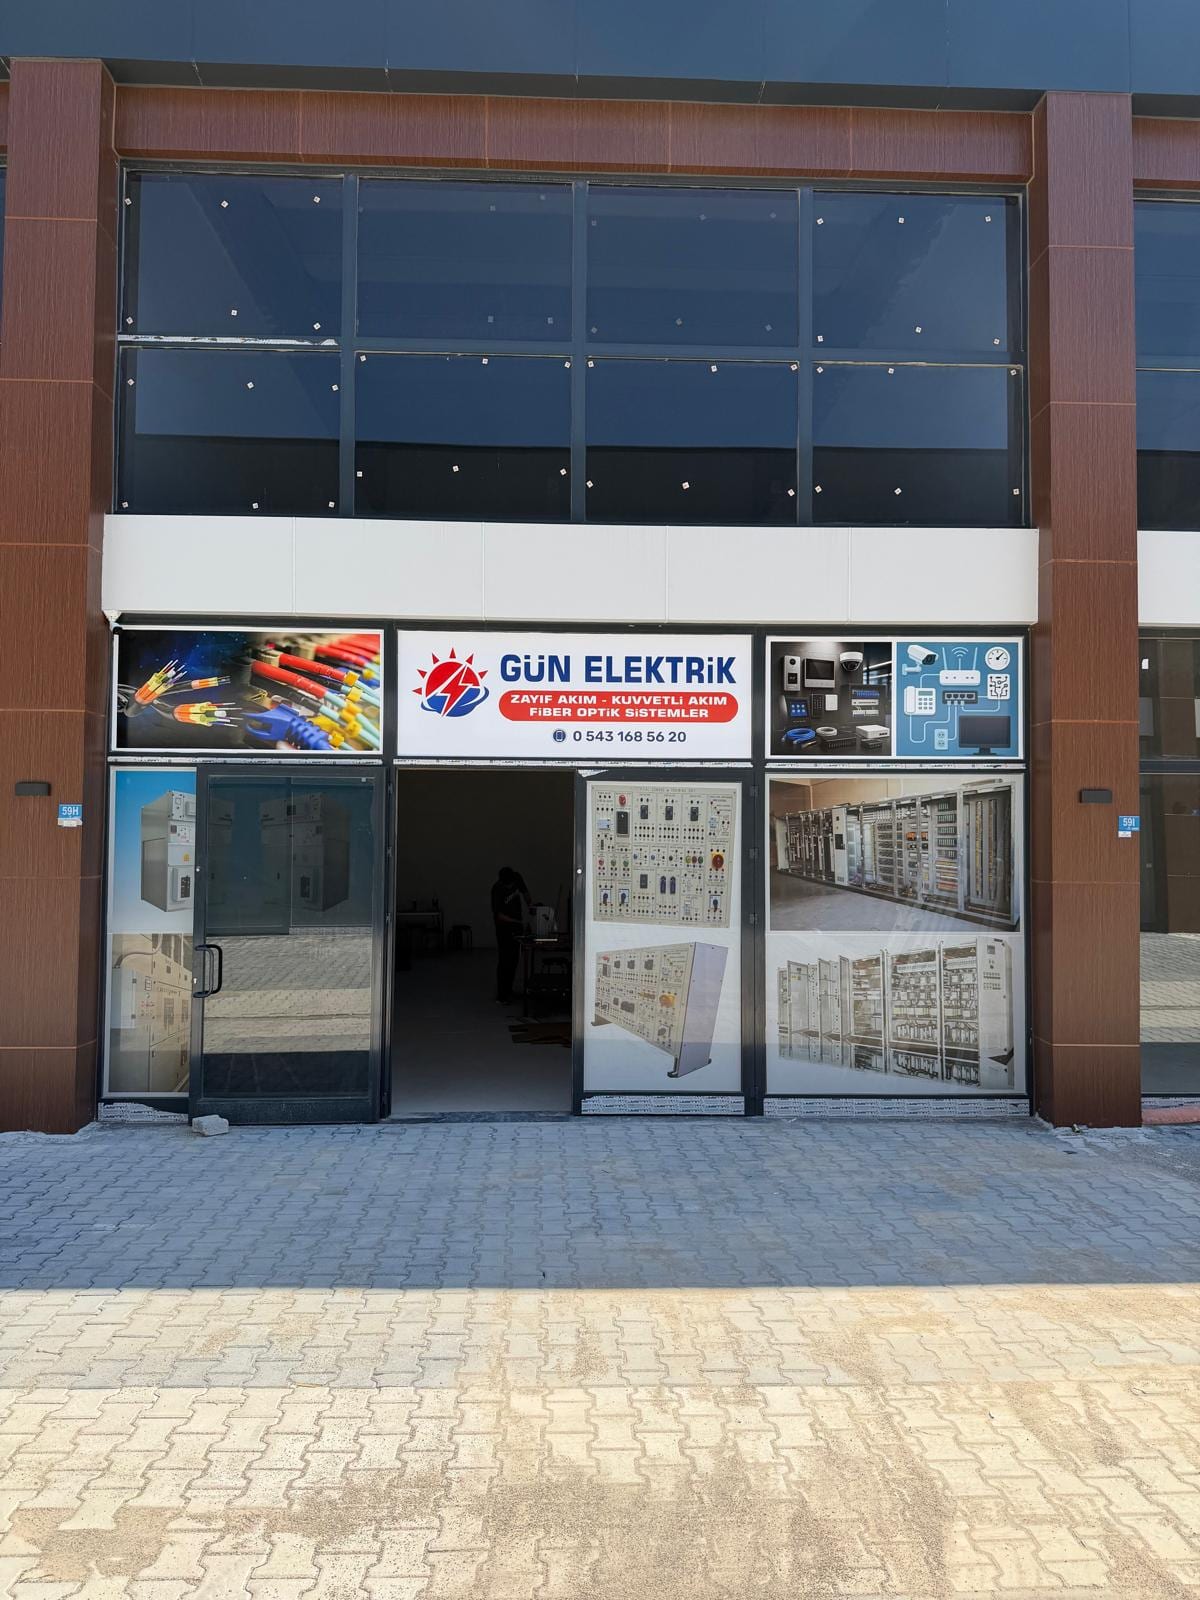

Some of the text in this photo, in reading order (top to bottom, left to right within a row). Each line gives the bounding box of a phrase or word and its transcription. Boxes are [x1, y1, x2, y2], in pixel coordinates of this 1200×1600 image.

[500, 654, 571, 682] GÜN
[510, 694, 553, 704] ZAYIF
[557, 695, 597, 705] AKIM
[687, 696, 728, 706] AKIM
[572, 730, 687, 743] 0 543 168 56 20
[62, 806, 79, 816] 59H
